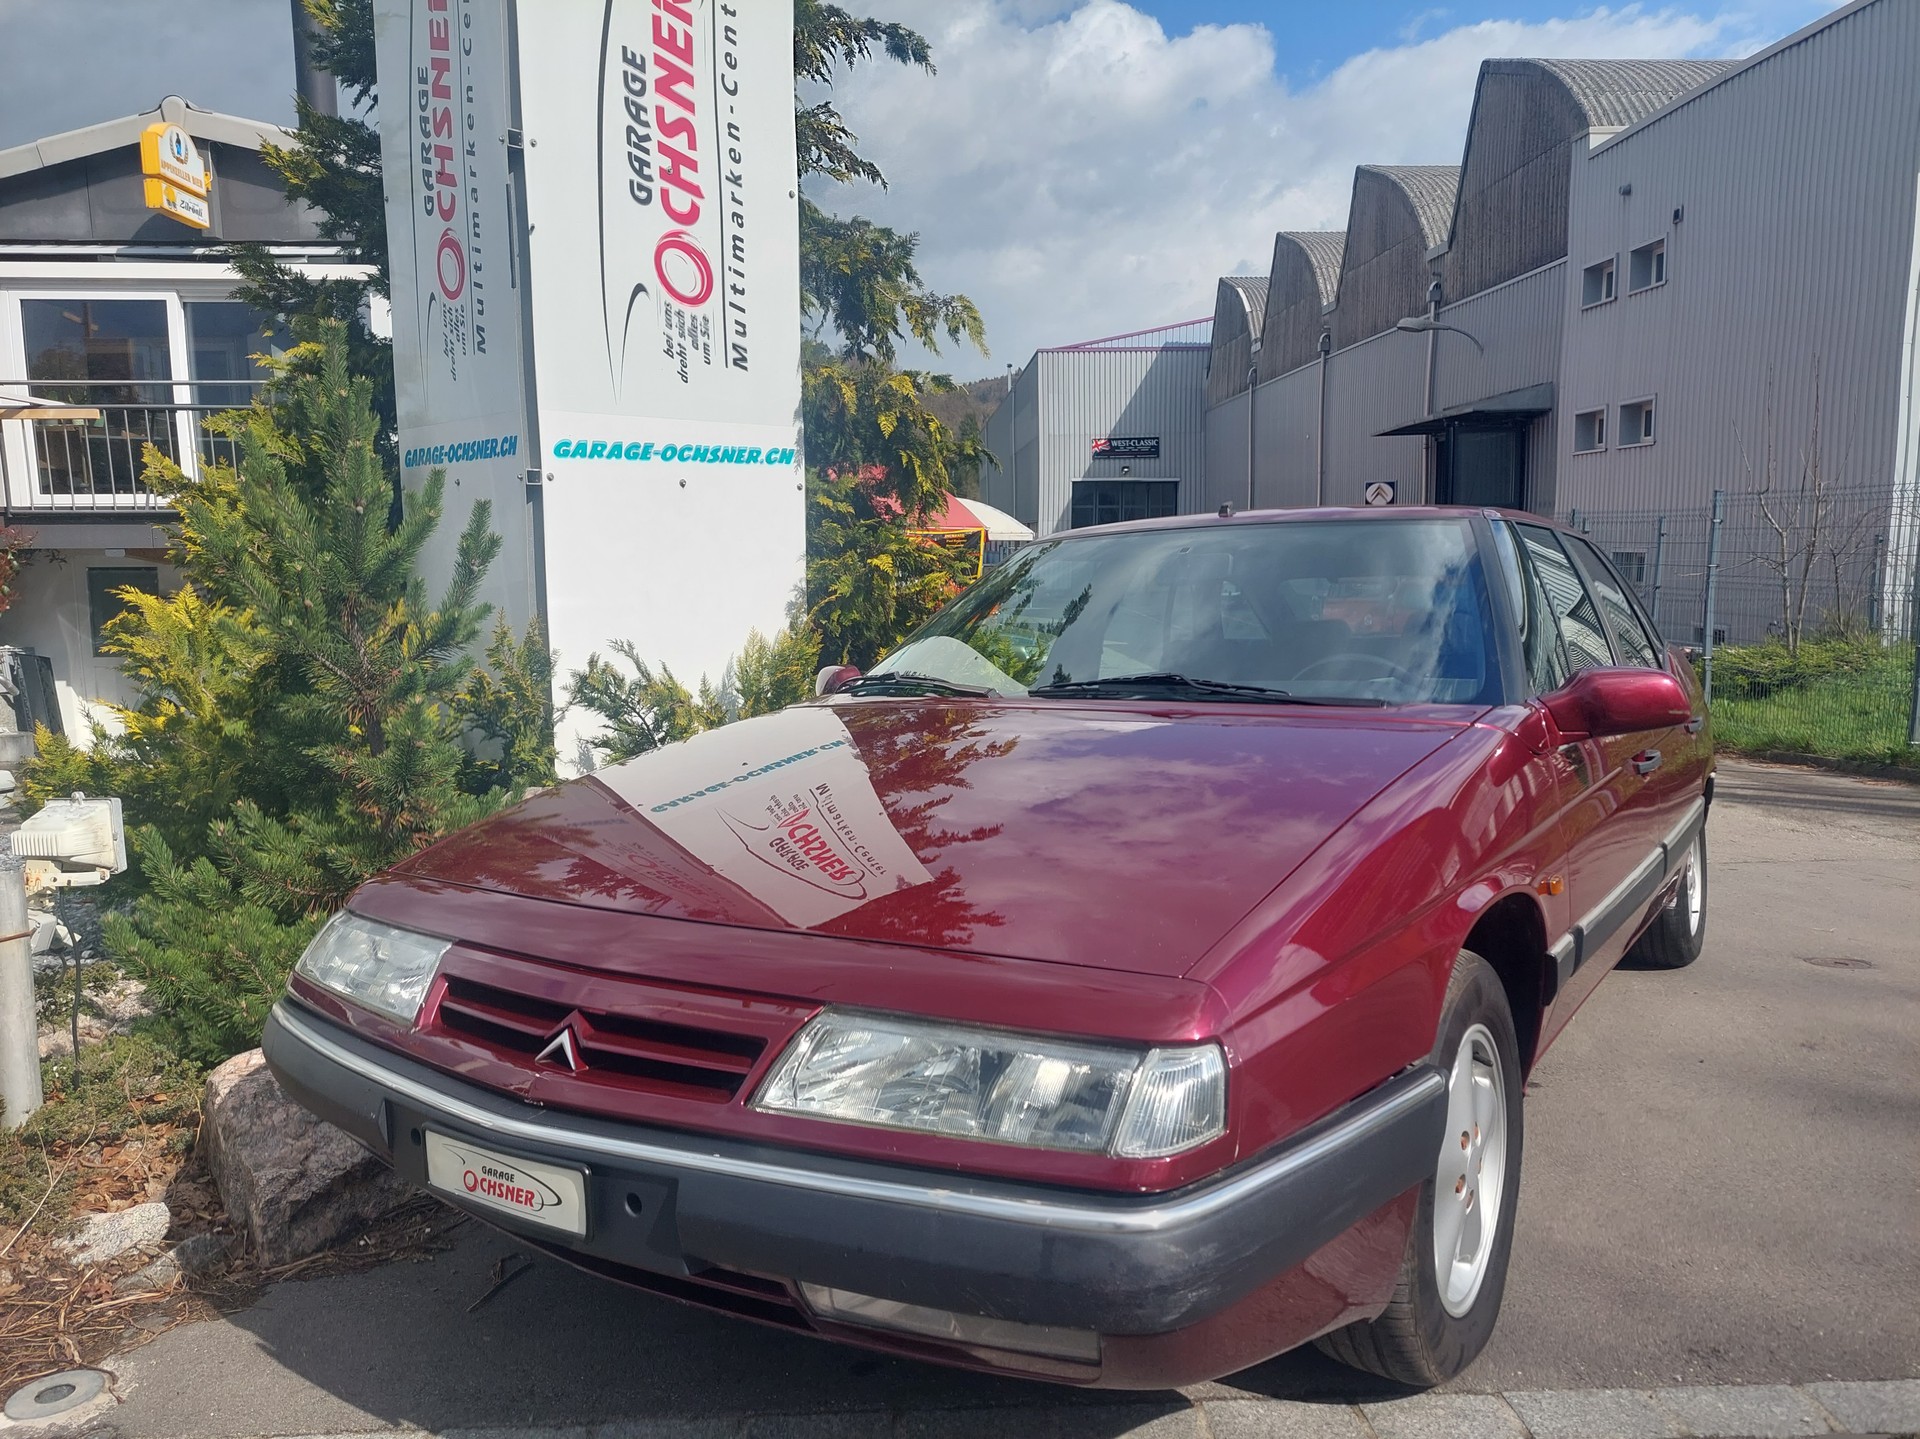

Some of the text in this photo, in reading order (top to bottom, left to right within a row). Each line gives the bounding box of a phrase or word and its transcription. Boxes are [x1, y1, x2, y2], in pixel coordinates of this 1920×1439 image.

[417, 66, 434, 217] GARAGE
[622, 46, 653, 206] GARAGE
[462, 0, 486, 354] Multimarken-Ce
[453, 306, 461, 343] alles
[461, 332, 467, 356] um
[663, 300, 675, 360] bei uns
[687, 312, 699, 351] alles
[700, 314, 711, 366] um Sie
[449, 339, 457, 382] dreht
[674, 308, 689, 384] dreht sich
[404, 435, 518, 468] GARAGE-OCHSNER.CH
[553, 438, 795, 465] GARAGE-OCHSNER.CH
[1111, 439, 1159, 447] WEST-CLASSIC
[463, 1170, 536, 1208] OCHSNER
[481, 1165, 515, 1183] GARAGE
